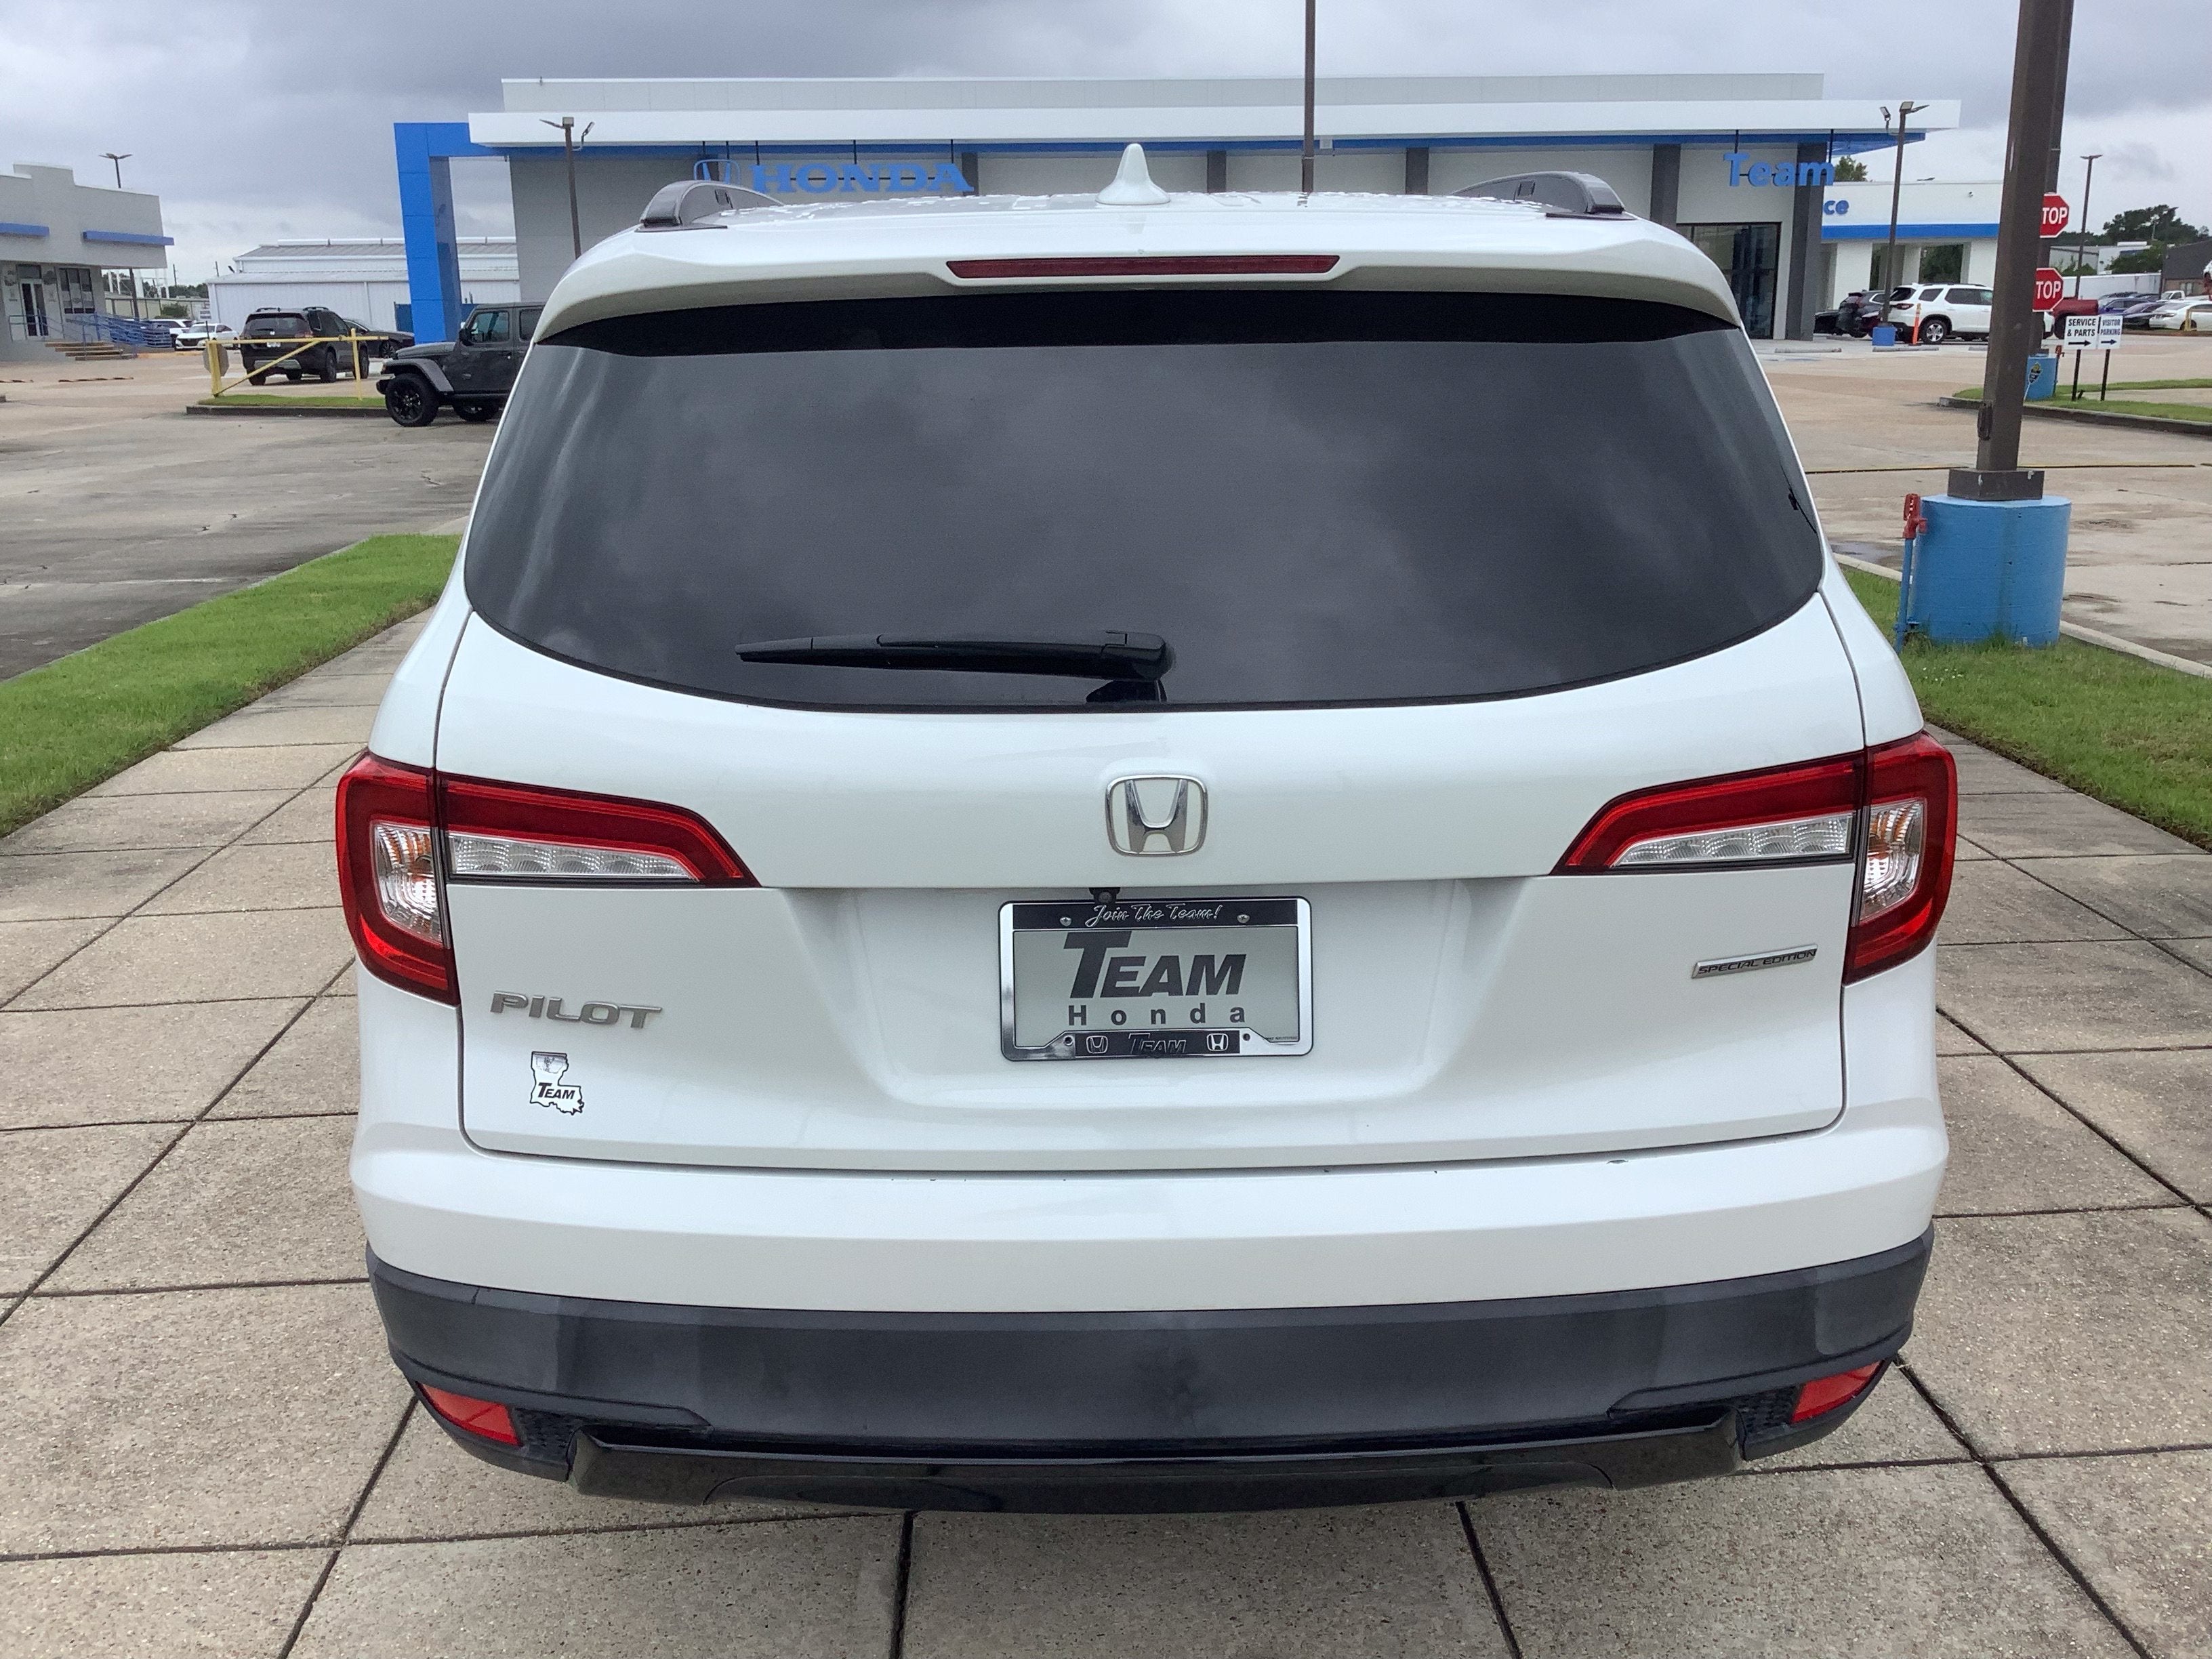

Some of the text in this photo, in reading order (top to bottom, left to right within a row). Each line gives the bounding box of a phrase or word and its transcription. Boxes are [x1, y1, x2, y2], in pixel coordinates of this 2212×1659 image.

[750, 163, 975, 194] HONDA
[1723, 152, 1835, 187] Team
[2041, 206, 2068, 225] TOP
[2035, 280, 2062, 300] TOP
[2067, 329, 2095, 337] & PARTS
[2068, 319, 2096, 327] SERVICE
[1084, 903, 1223, 928] Join The Team!
[1063, 930, 1247, 999] TEAM
[1698, 948, 1818, 975] SPECIAL EDITION
[490, 990, 663, 1029] PILOT
[1068, 1002, 1246, 1026] Honda
[1128, 1032, 1187, 1055] TEAM
[537, 1082, 576, 1100] TEAM
